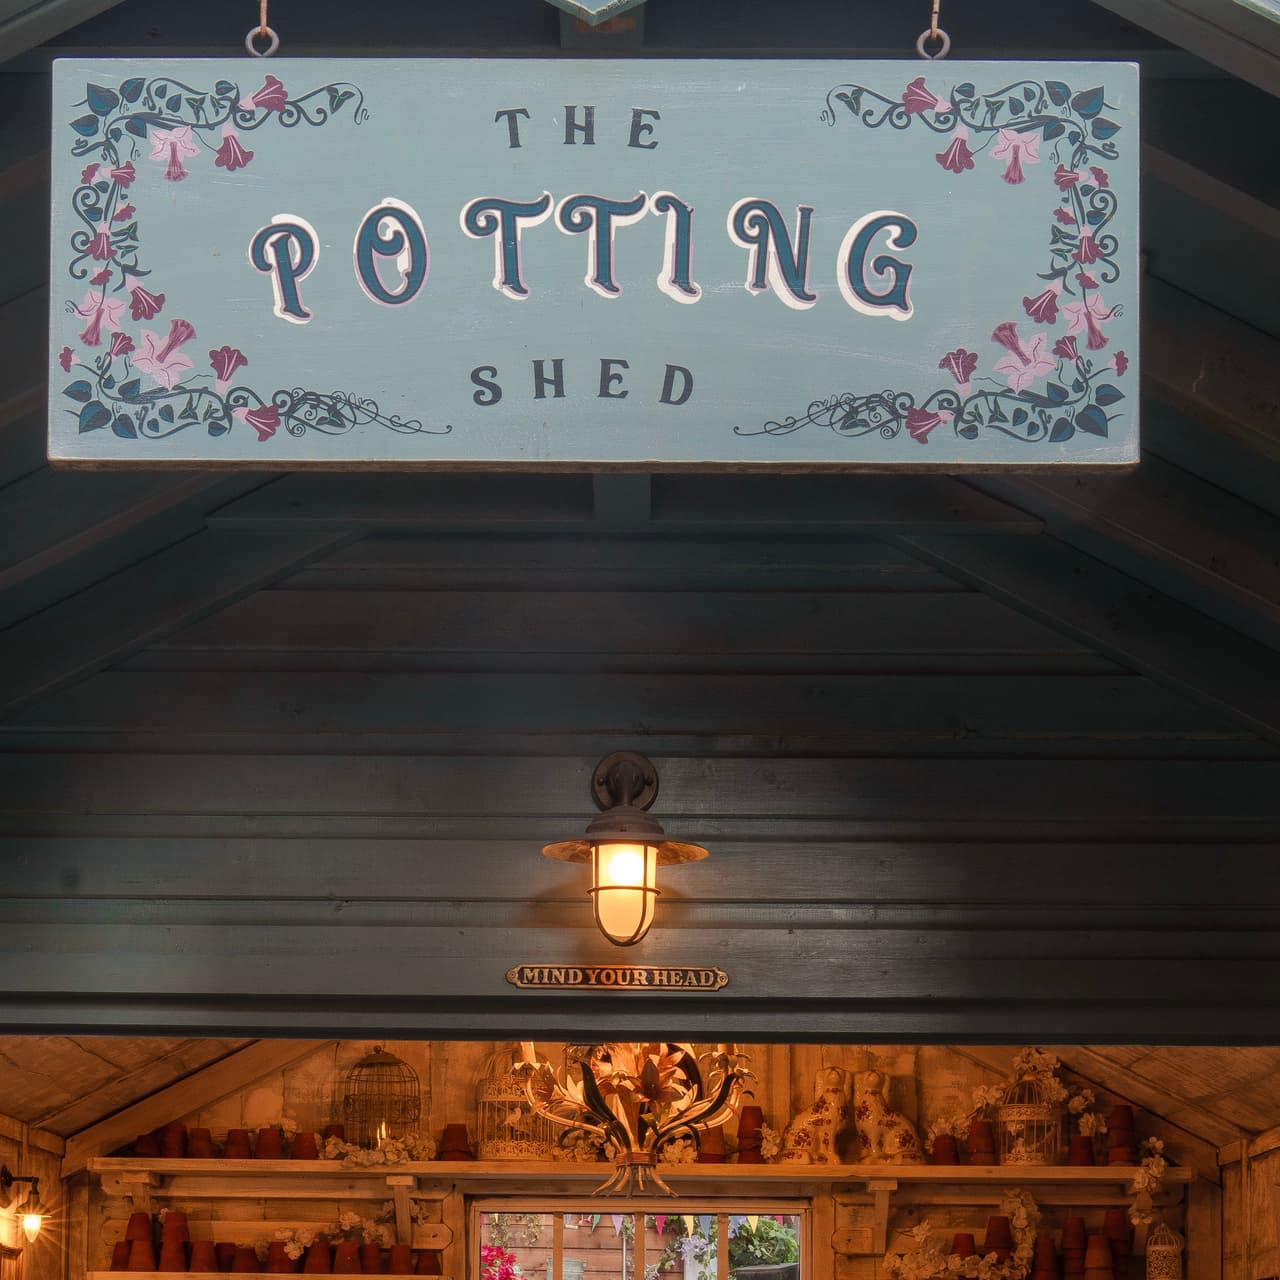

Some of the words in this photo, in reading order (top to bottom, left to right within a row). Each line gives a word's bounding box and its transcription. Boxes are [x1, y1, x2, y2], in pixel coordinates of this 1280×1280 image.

[494, 105, 661, 150] THE
[248, 190, 919, 324] POTTING
[470, 358, 694, 406] SHED
[522, 967, 583, 985] MIND
[587, 968, 649, 986] YOUR
[652, 970, 714, 987] HEAD
